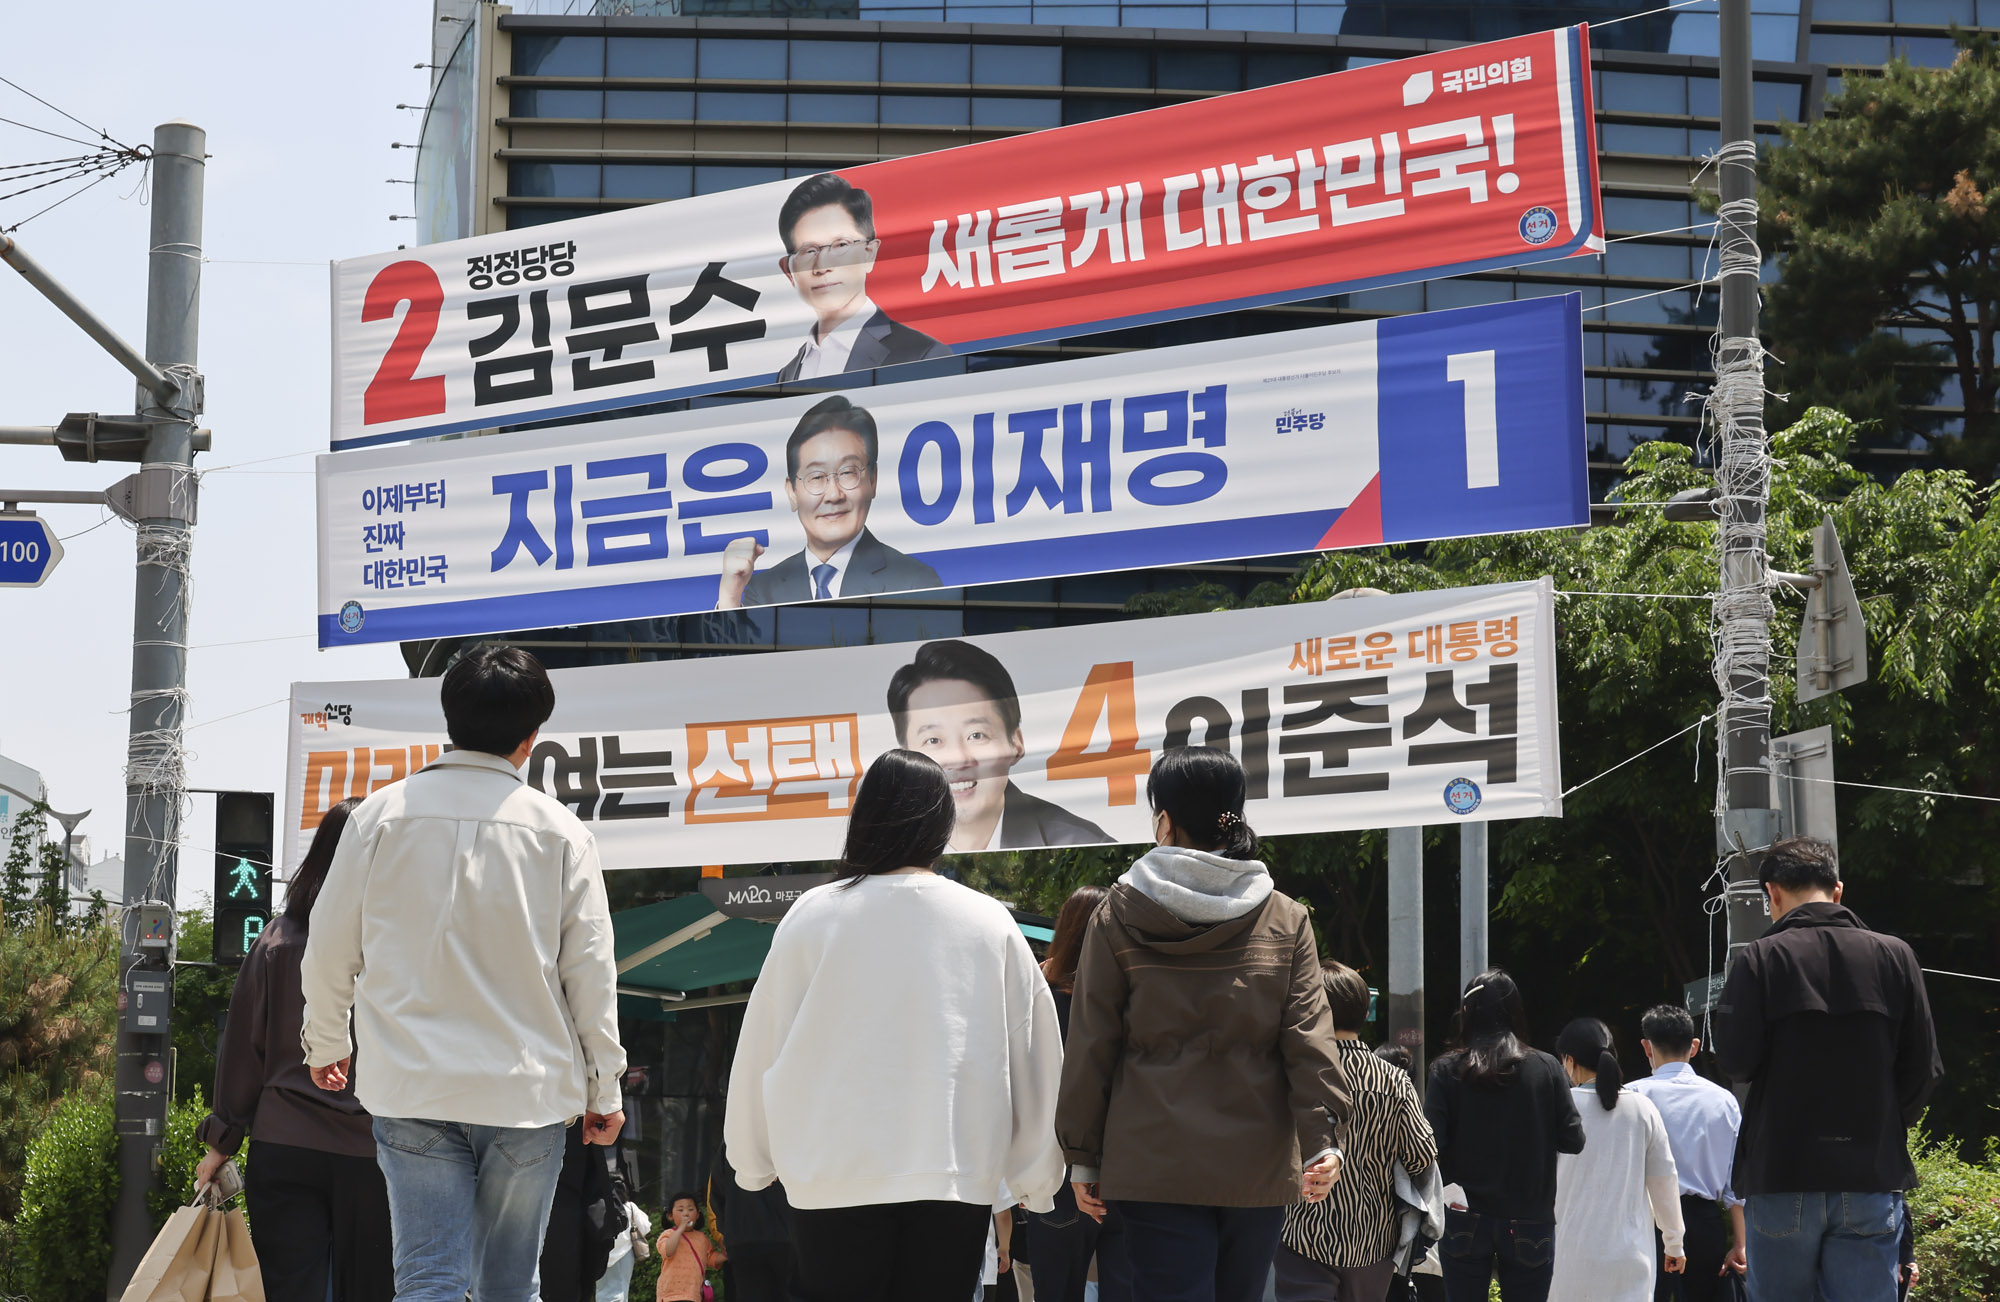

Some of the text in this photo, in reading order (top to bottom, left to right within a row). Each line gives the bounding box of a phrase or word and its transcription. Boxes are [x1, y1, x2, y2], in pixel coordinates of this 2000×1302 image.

[1441, 56, 1532, 94] 국민의힘
[921, 114, 1521, 293] 새롭게 대한민국!
[467, 240, 577, 290] 정정당당
[361, 259, 447, 426] 2
[467, 262, 767, 407] 김문수
[898, 384, 1229, 526] 이재명
[1275, 412, 1326, 434] 민주당
[1446, 349, 1499, 490] 1
[362, 480, 446, 517] 이제부터
[362, 522, 406, 552] 진짜
[491, 442, 773, 574] 지금은
[362, 555, 449, 591] 대한민국
[1288, 615, 1519, 676] 새로운 대통령
[301, 702, 352, 731] 개혁신당
[1046, 660, 1152, 807] 4
[1163, 663, 1519, 800] 이준석
[528, 736, 677, 821] 여는
[692, 720, 857, 815] 선택
